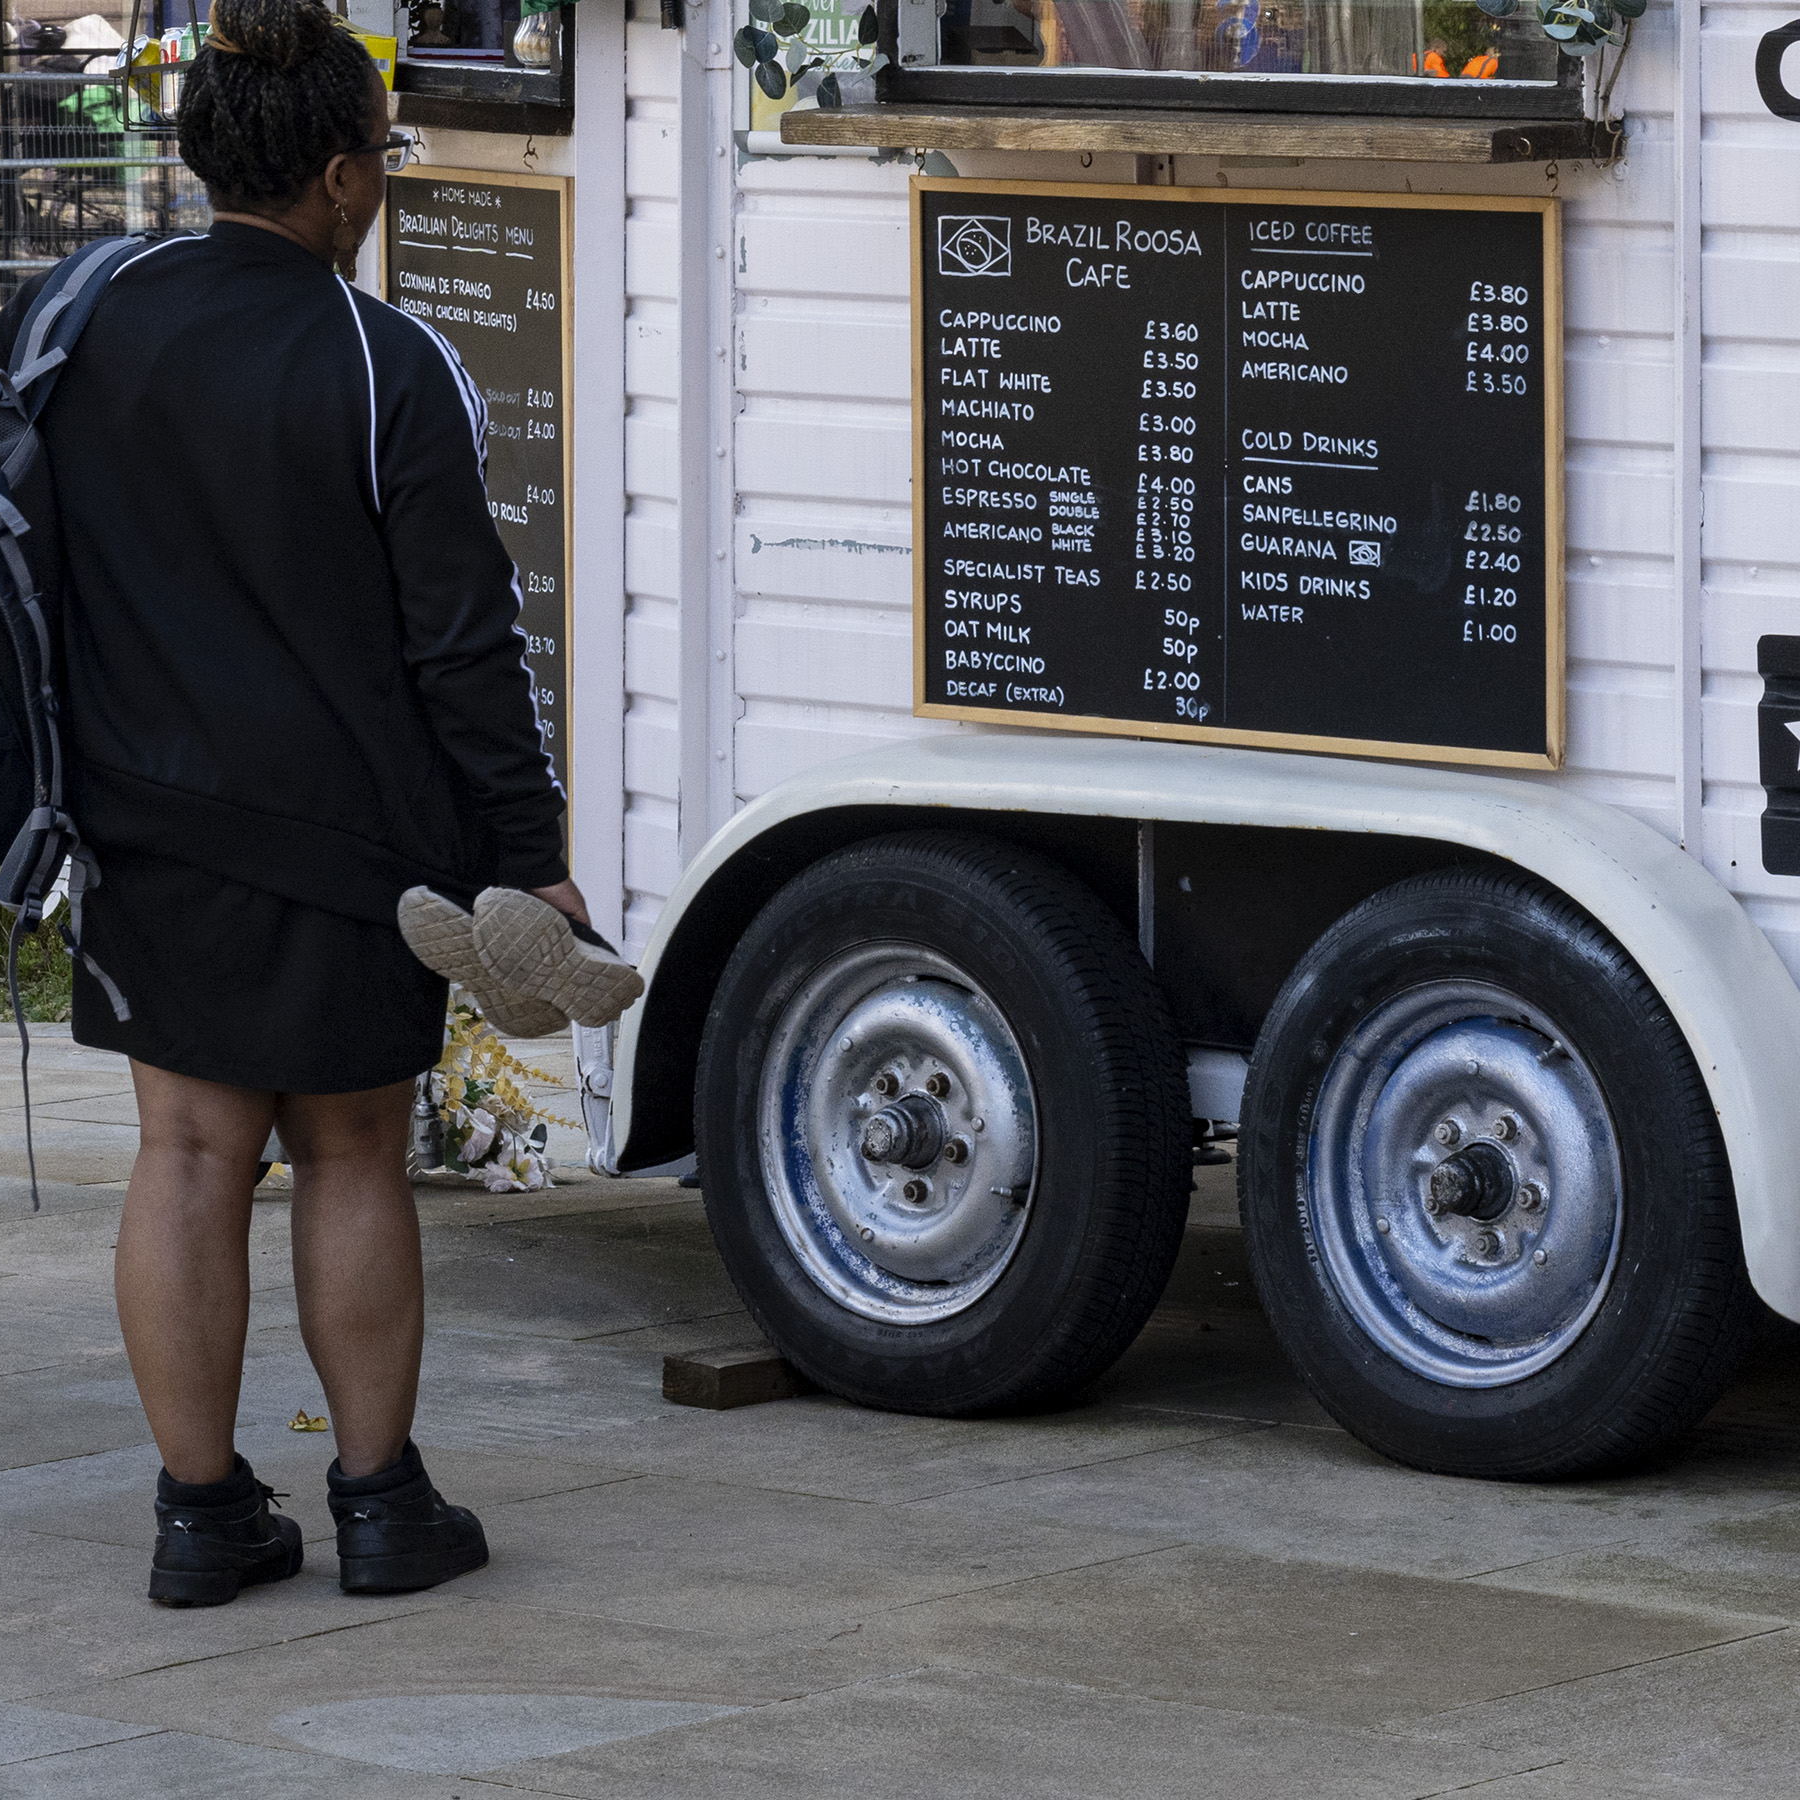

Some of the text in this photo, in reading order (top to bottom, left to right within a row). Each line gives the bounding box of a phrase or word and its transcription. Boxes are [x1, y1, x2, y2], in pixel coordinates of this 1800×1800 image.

[441, 186, 492, 206] HOME MADE
[398, 209, 534, 246] BRAZILIAN DELIGHTS MENU
[1026, 216, 1202, 256] BRAZIL ROOSA
[1250, 221, 1373, 245] ICED COFFEE
[1066, 257, 1131, 289] CAFE
[1241, 269, 1528, 305] CAPPUCCINO £3.80
[399, 271, 555, 311] COXINHA DE FRANGO £4.50
[400, 295, 518, 333] (GOLDEN CHICKEN DELIGHTS)
[939, 309, 1199, 342] CAPPUCCINO £3.60
[1241, 301, 1528, 333] LATTE £3.80
[941, 337, 1199, 371] LATTE £3.50
[1242, 331, 1529, 364] MOCHA £4.00
[941, 368, 1196, 400] FLAT WHITE £3.50
[1241, 361, 1527, 395] AMERICANO £3.50
[527, 388, 554, 408] £4.00
[527, 419, 555, 440] £4.00
[941, 399, 1196, 436] MACHIATO £3.00
[941, 430, 1194, 464] MOCHA £3.80
[1241, 429, 1378, 459] COLD DRINKS
[941, 457, 1196, 496] HOT CHOCOLATE £4.00
[527, 484, 555, 505] £4.00
[942, 486, 1194, 513] ESPRESSO SINGLE £2.50
[1243, 475, 1521, 513] CANS £1.80
[501, 503, 528, 525] ROLLS
[1049, 505, 1191, 529] DOUBLE £2.70
[1242, 504, 1521, 543] SANPELLEGRINO £2.50
[943, 521, 1192, 545] AMERICANO BLACK £3.10
[1051, 538, 1195, 563] WHITE £3.20
[1240, 533, 1520, 573] GUARANA £2.40
[528, 571, 555, 593] £2.50
[943, 558, 1192, 592] SPECIALIST TEAS £2.50
[1241, 570, 1517, 607] KIDS DRINKS £1.20
[945, 589, 1200, 635] SYRUPS 50p
[1241, 604, 1517, 643] WATER £1.00
[944, 620, 1198, 664] OAT MILK 50p
[945, 650, 1200, 691] BABYCCINO £2.00
[946, 680, 998, 697] DECAF
[1006, 682, 1065, 707] (EXTRA)
